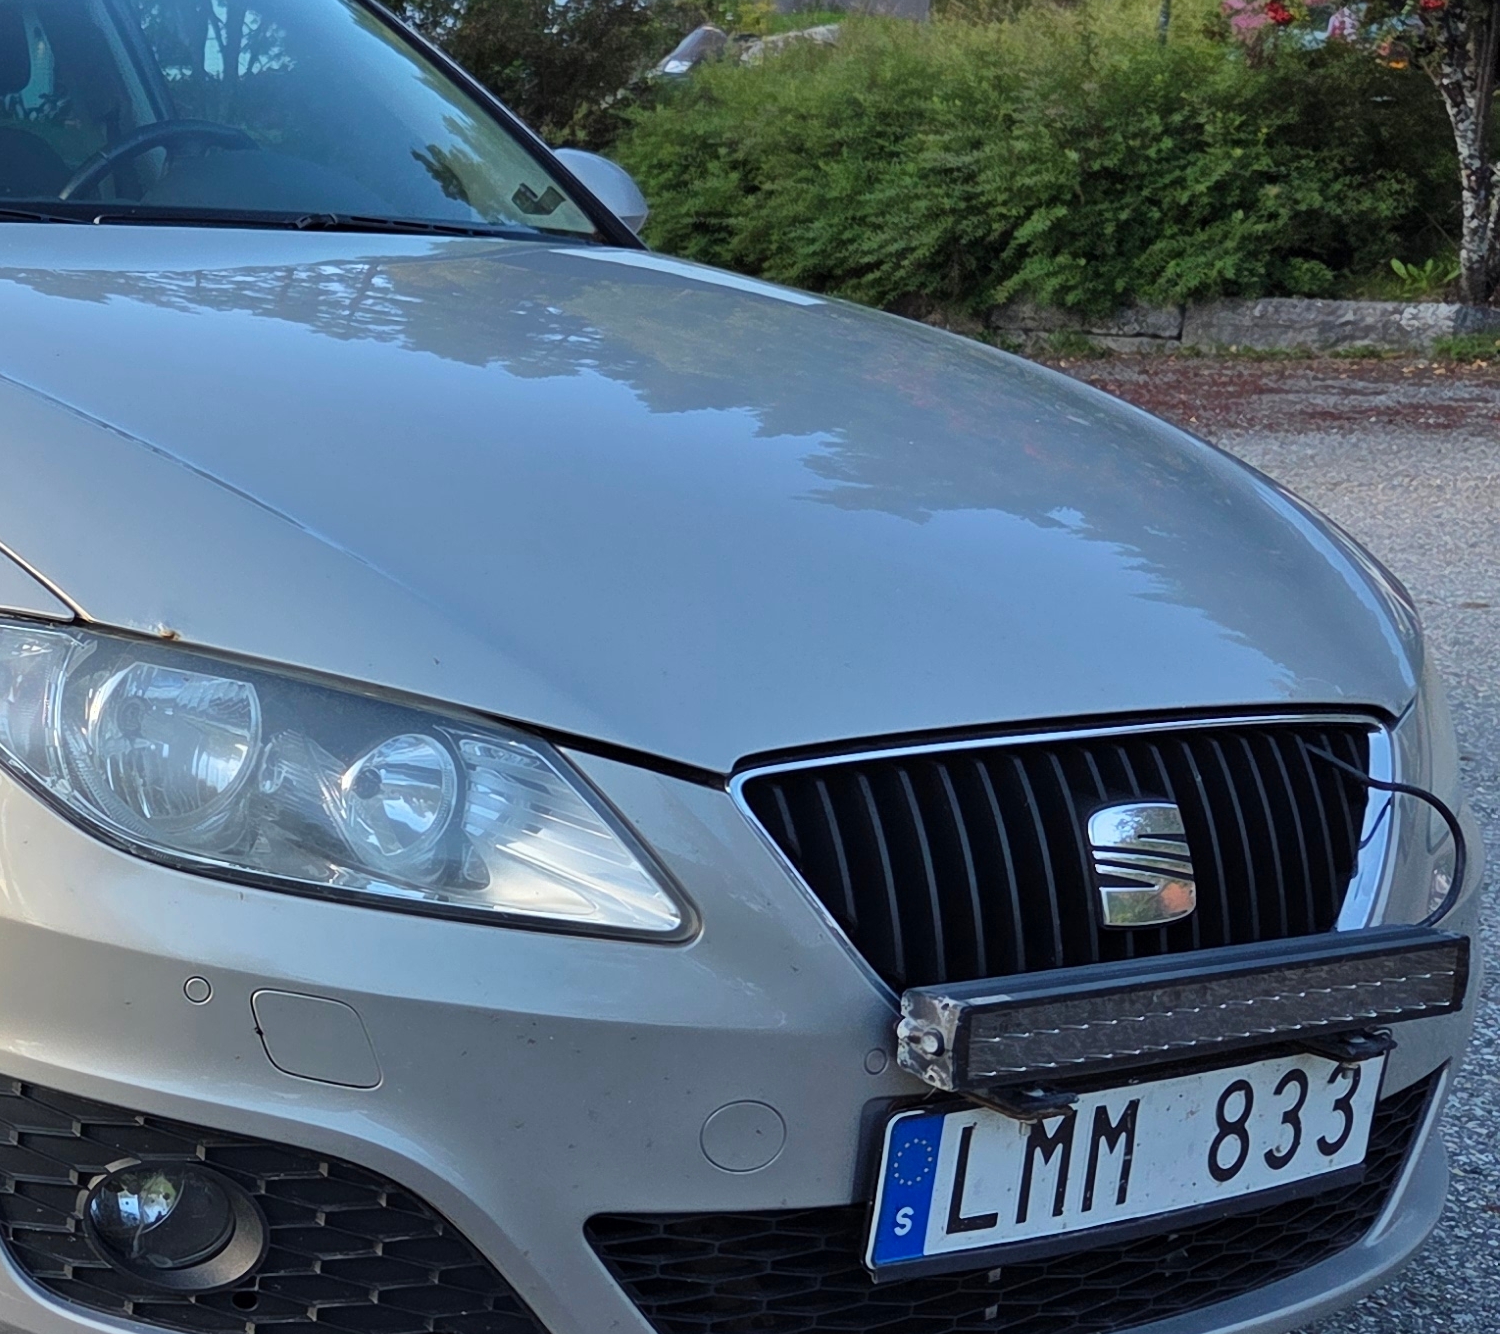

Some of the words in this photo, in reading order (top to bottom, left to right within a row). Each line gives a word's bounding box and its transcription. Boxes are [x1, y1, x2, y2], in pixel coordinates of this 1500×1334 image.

[946, 1098, 1141, 1235] LMM
[1207, 1061, 1362, 1183] 833
[893, 1206, 915, 1237] S
